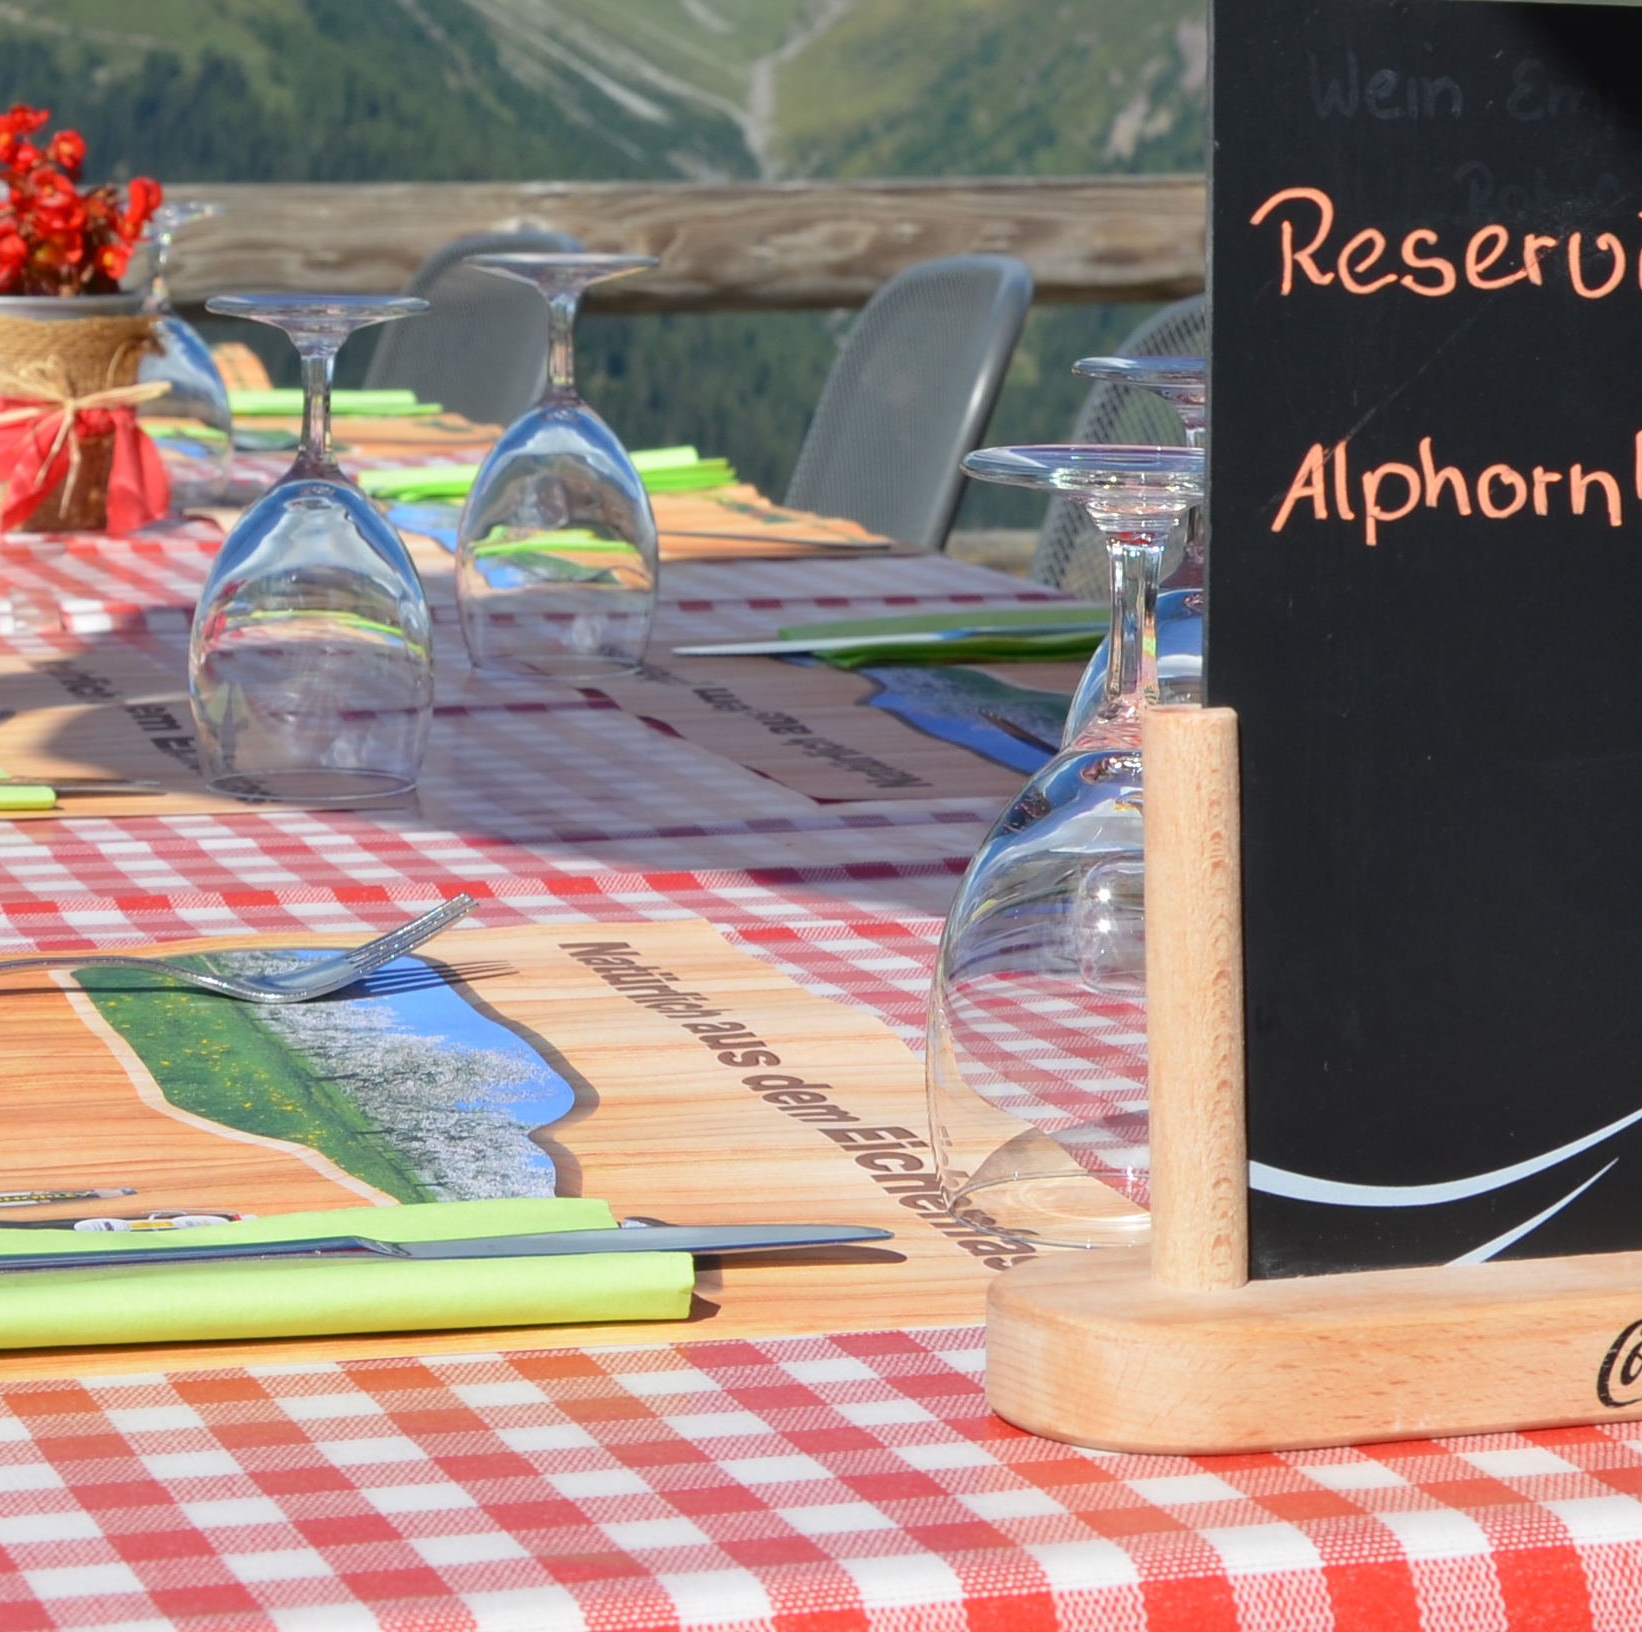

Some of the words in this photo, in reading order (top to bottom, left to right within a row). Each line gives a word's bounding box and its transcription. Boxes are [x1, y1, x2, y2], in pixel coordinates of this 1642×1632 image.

[558, 941, 733, 1019] Natürlich
[681, 1021, 781, 1068] aus
[741, 1074, 861, 1122] dem
